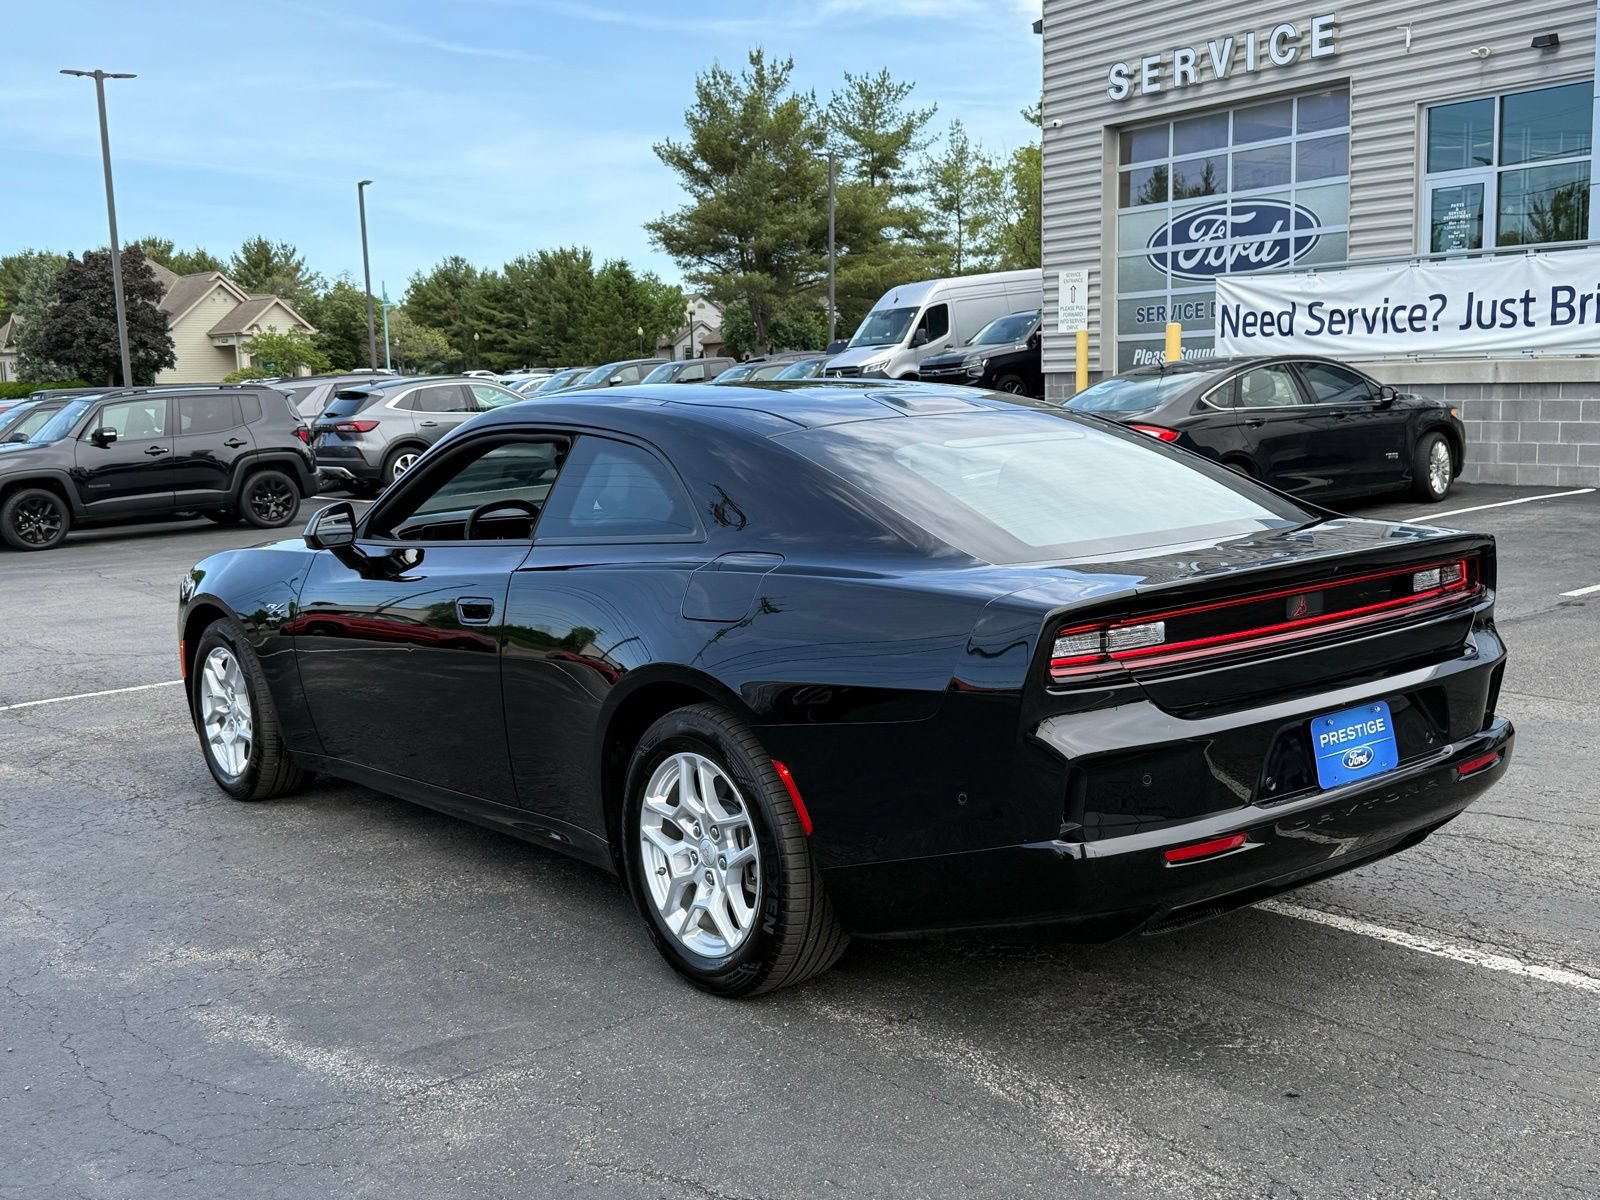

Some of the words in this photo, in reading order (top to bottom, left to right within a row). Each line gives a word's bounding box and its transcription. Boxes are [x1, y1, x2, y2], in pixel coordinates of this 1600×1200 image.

[1107, 12, 1336, 101] SERVICE
[1178, 211, 1284, 269] Ford
[1136, 302, 1205, 323] SERVICE
[1220, 302, 1297, 338] Need
[1304, 293, 1447, 336] Service?
[1459, 289, 1537, 331] Just
[1132, 348, 1166, 365] Pleas
[1319, 718, 1386, 748] PRESTIGE
[1348, 749, 1369, 767] Ford
[1294, 780, 1440, 831] DAYTONA
